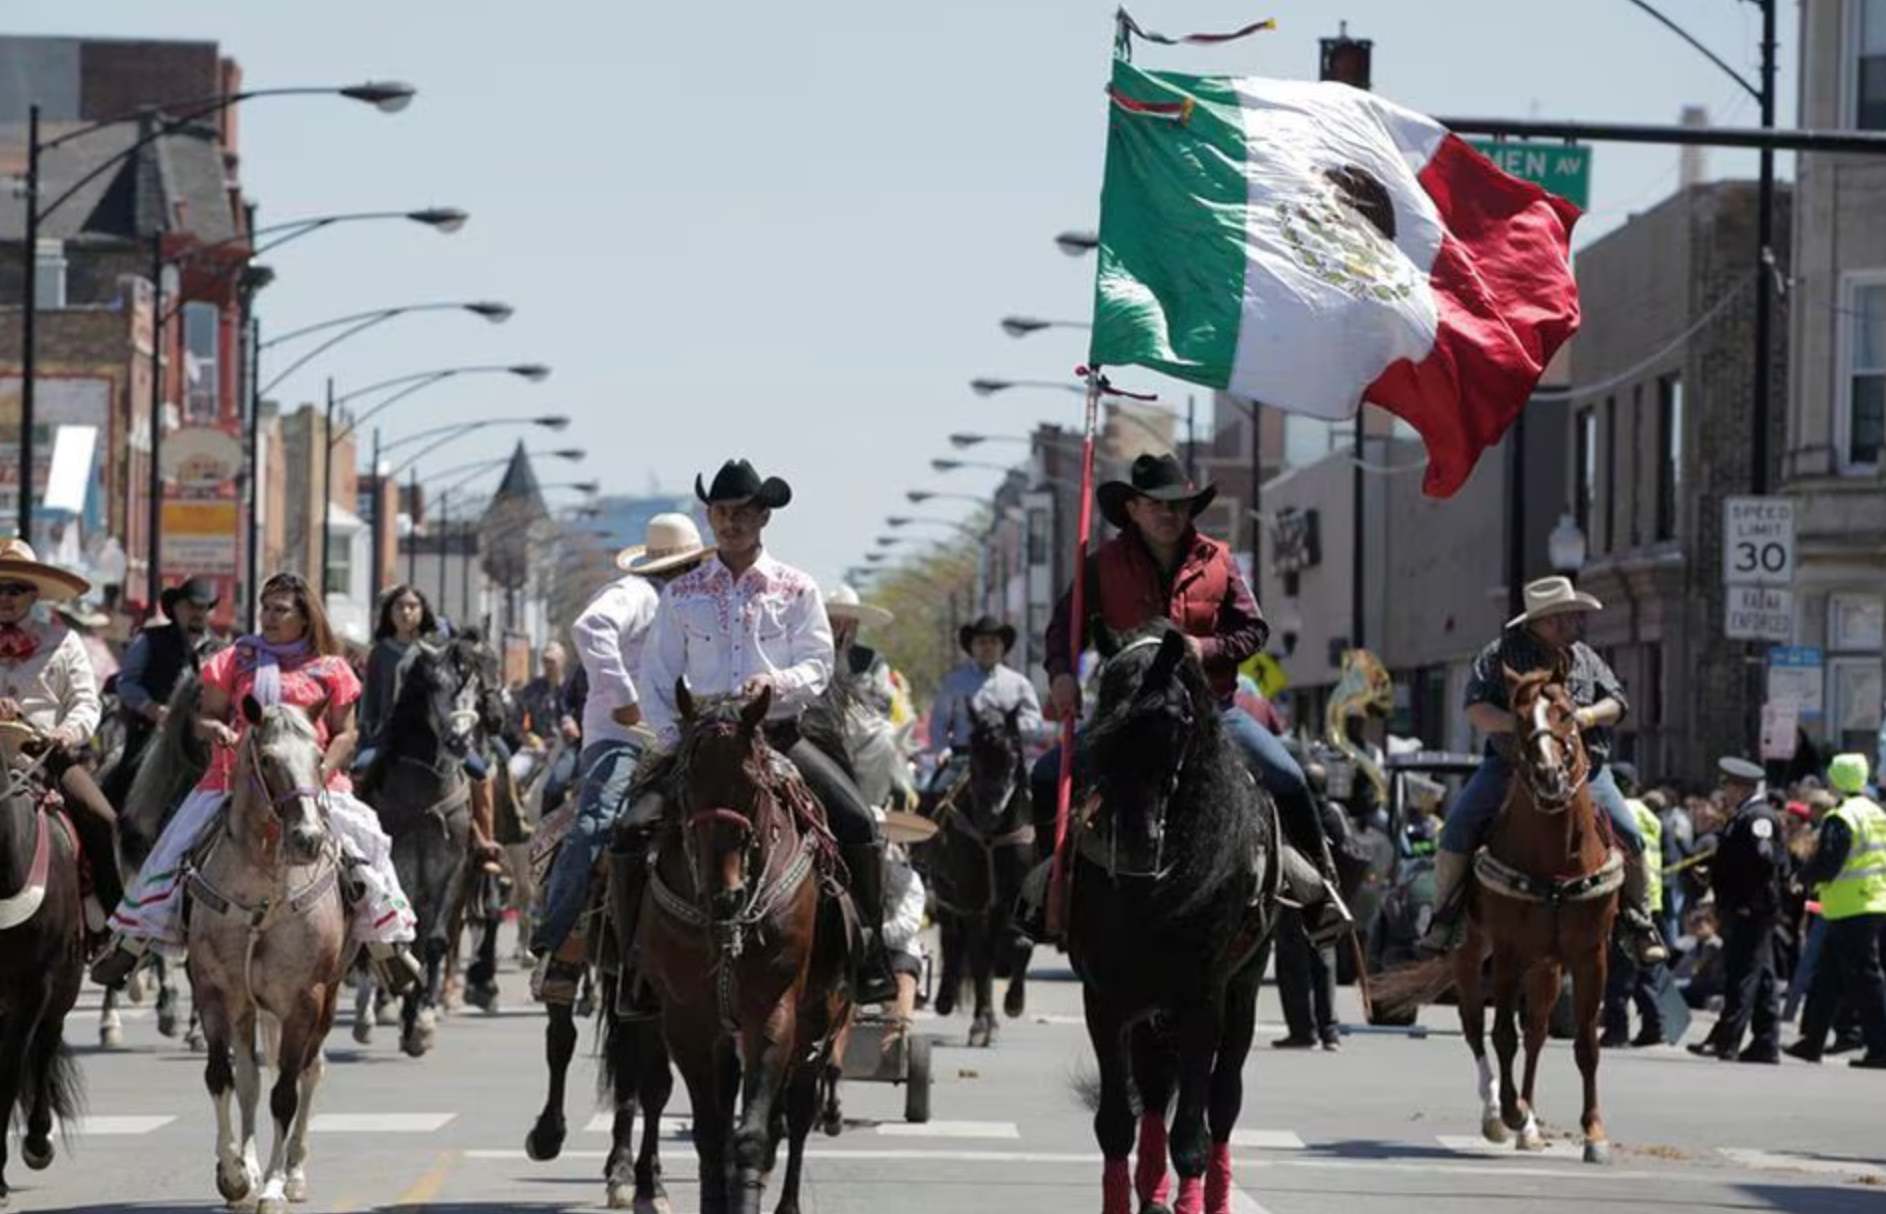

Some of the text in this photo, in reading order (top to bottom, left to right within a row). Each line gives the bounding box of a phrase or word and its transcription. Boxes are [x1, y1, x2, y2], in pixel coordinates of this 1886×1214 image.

[1555, 156, 1581, 175] AV
[1733, 504, 1790, 520] SPEED
[1738, 522, 1782, 536] LIMIT
[1735, 542, 1786, 573] 30
